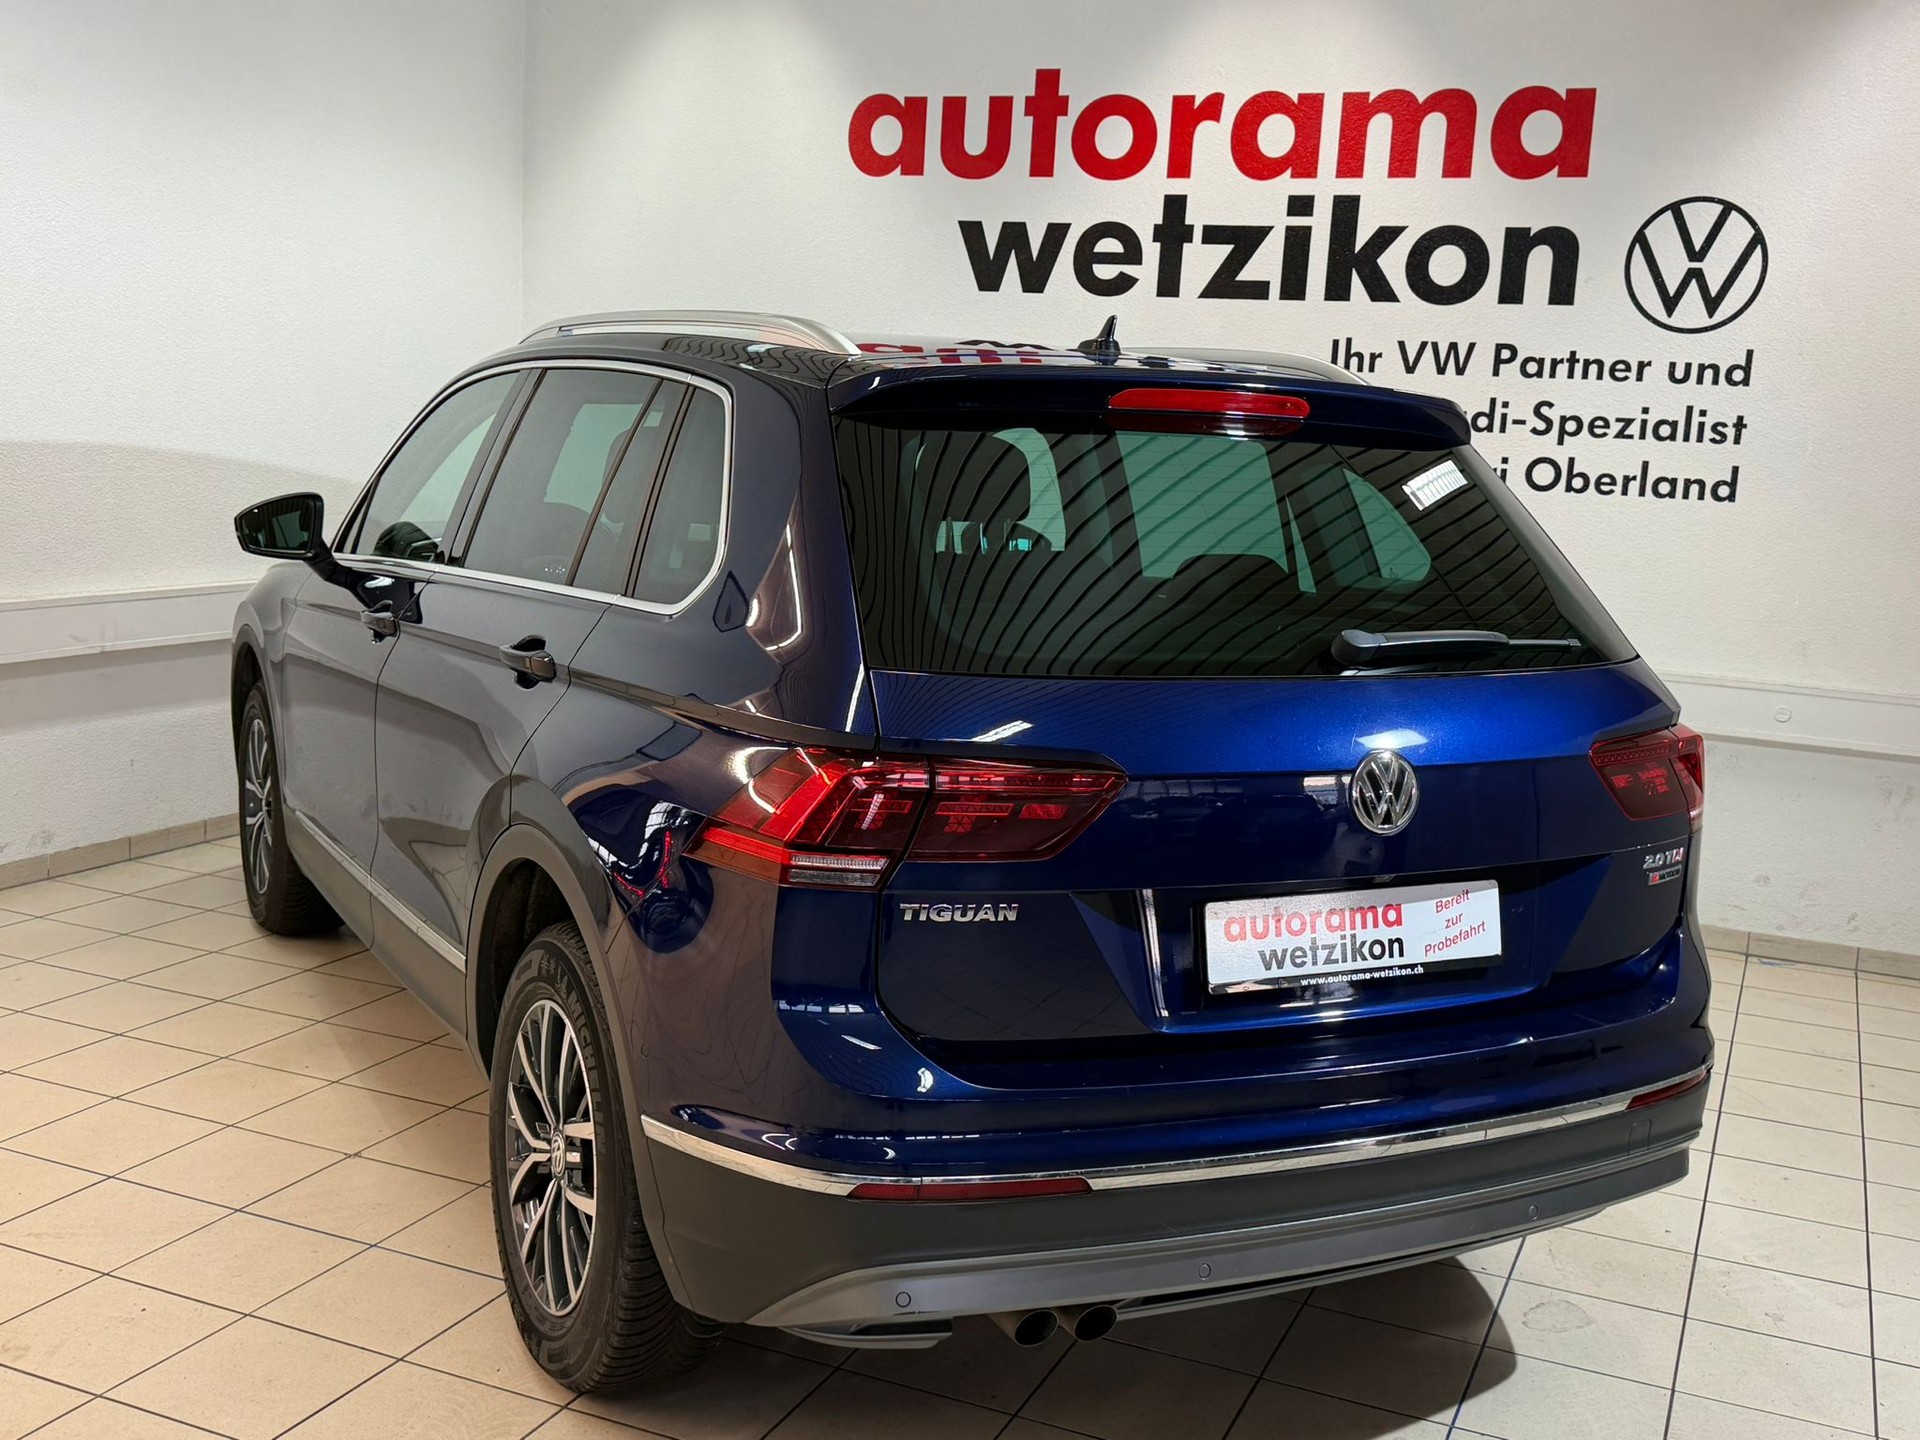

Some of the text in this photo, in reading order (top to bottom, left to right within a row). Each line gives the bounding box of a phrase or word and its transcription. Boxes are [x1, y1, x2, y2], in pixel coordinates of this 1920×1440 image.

[847, 68, 1597, 181] autorama
[958, 194, 1580, 306] wetzikon
[1331, 337, 1754, 387] Ihr VW Partner und
[1464, 397, 1748, 446] di-Spezialist
[1525, 456, 1740, 503] Oberland
[899, 903, 1019, 922] TIGUAN
[1434, 889, 1471, 915] Bereit
[1444, 911, 1464, 929] zur
[1223, 903, 1404, 942] autorama
[1423, 920, 1487, 958] Probefahrt
[1258, 933, 1405, 972] wetzikon
[1300, 965, 1425, 986] www.autorama-wetzikon.ch
